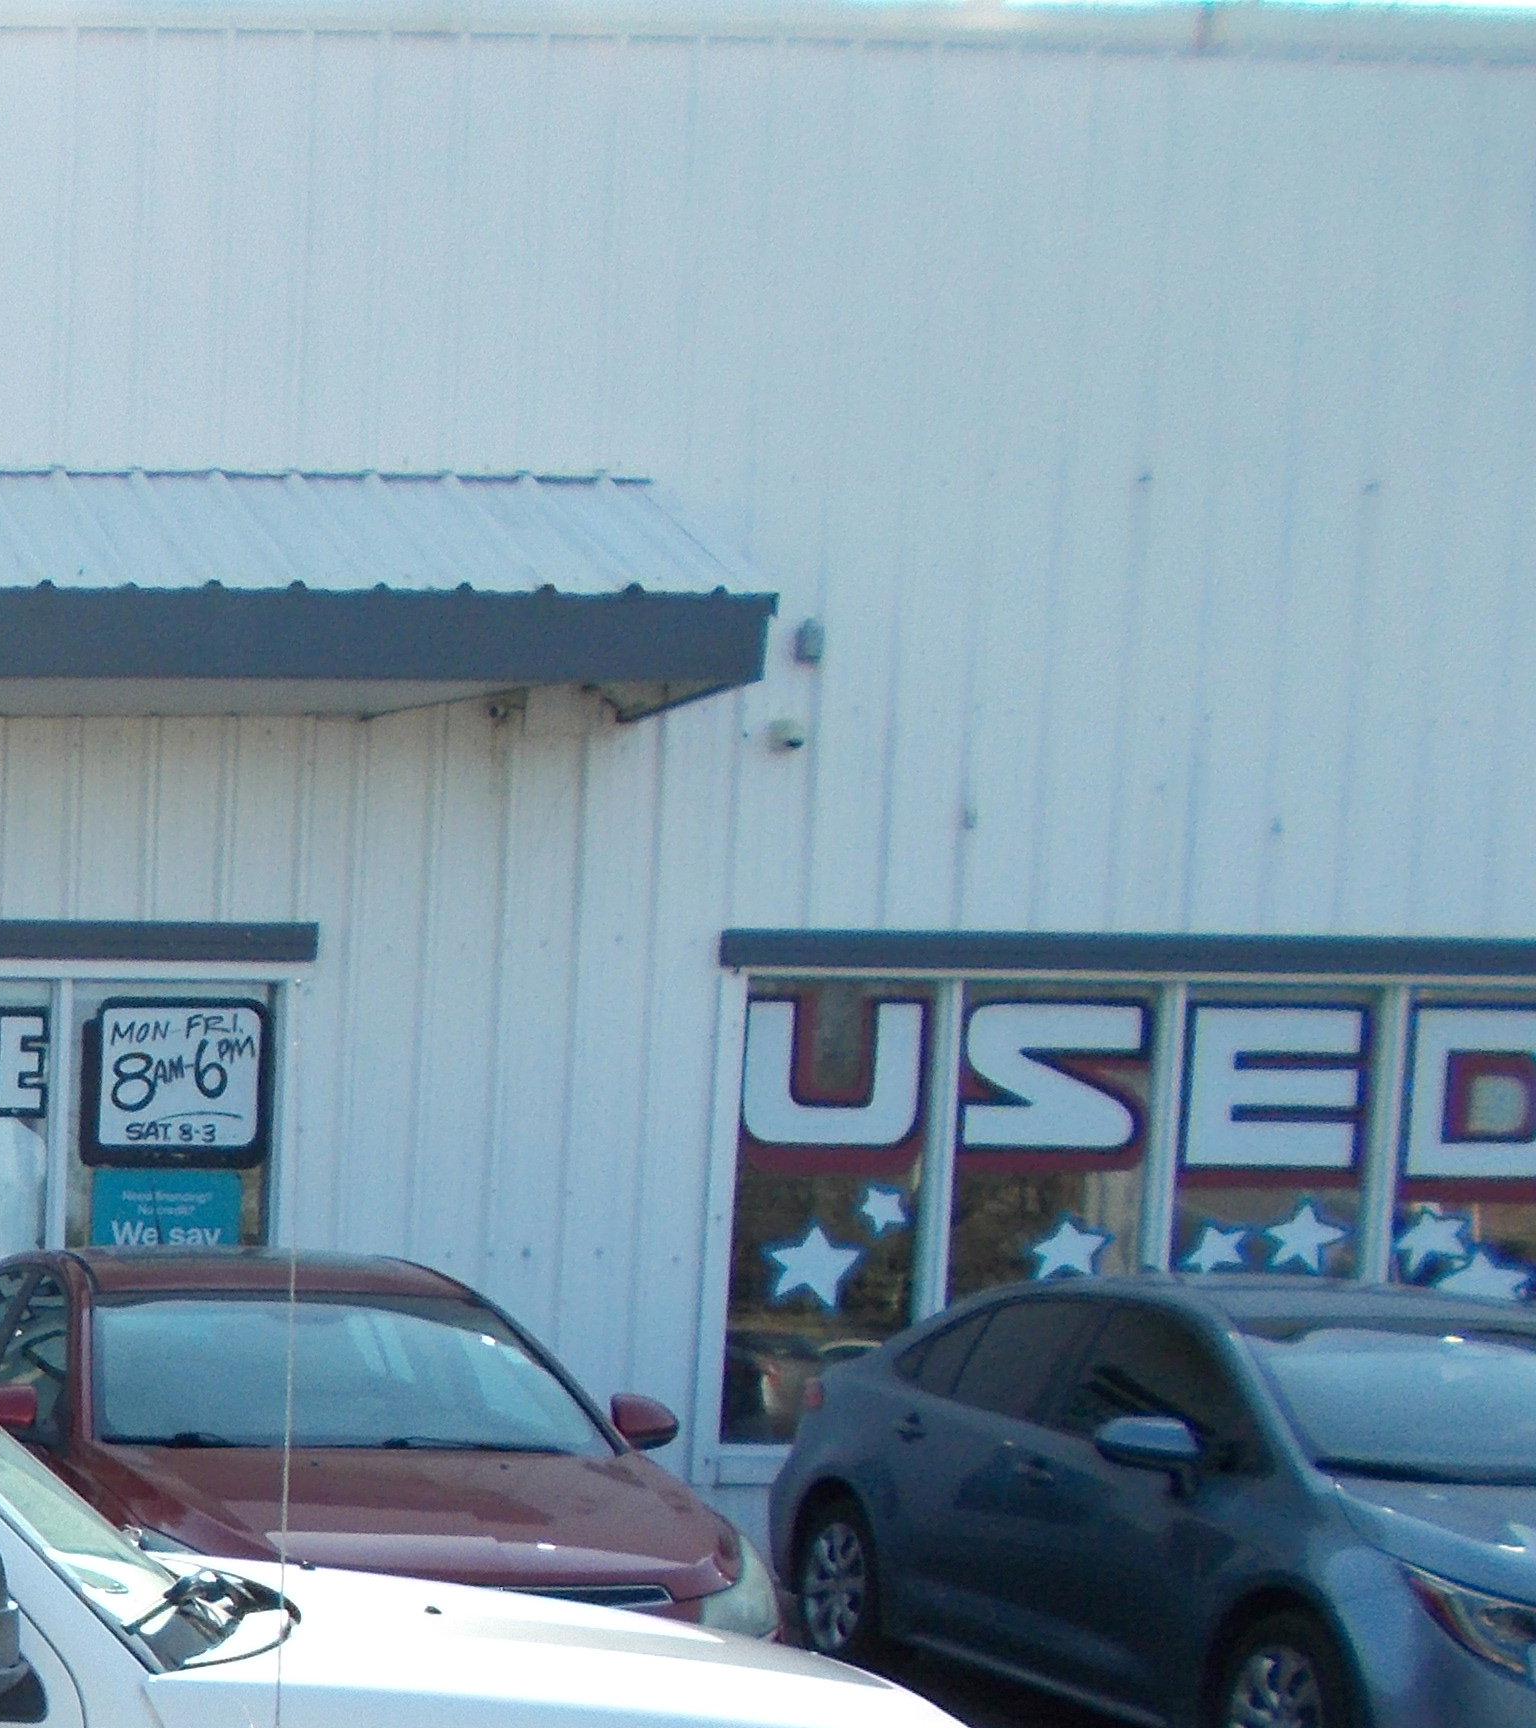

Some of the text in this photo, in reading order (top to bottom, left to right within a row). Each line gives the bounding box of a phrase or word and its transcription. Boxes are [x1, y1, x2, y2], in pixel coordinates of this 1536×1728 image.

[741, 998, 1536, 1196] USED
[111, 1219, 223, 1246] We say
